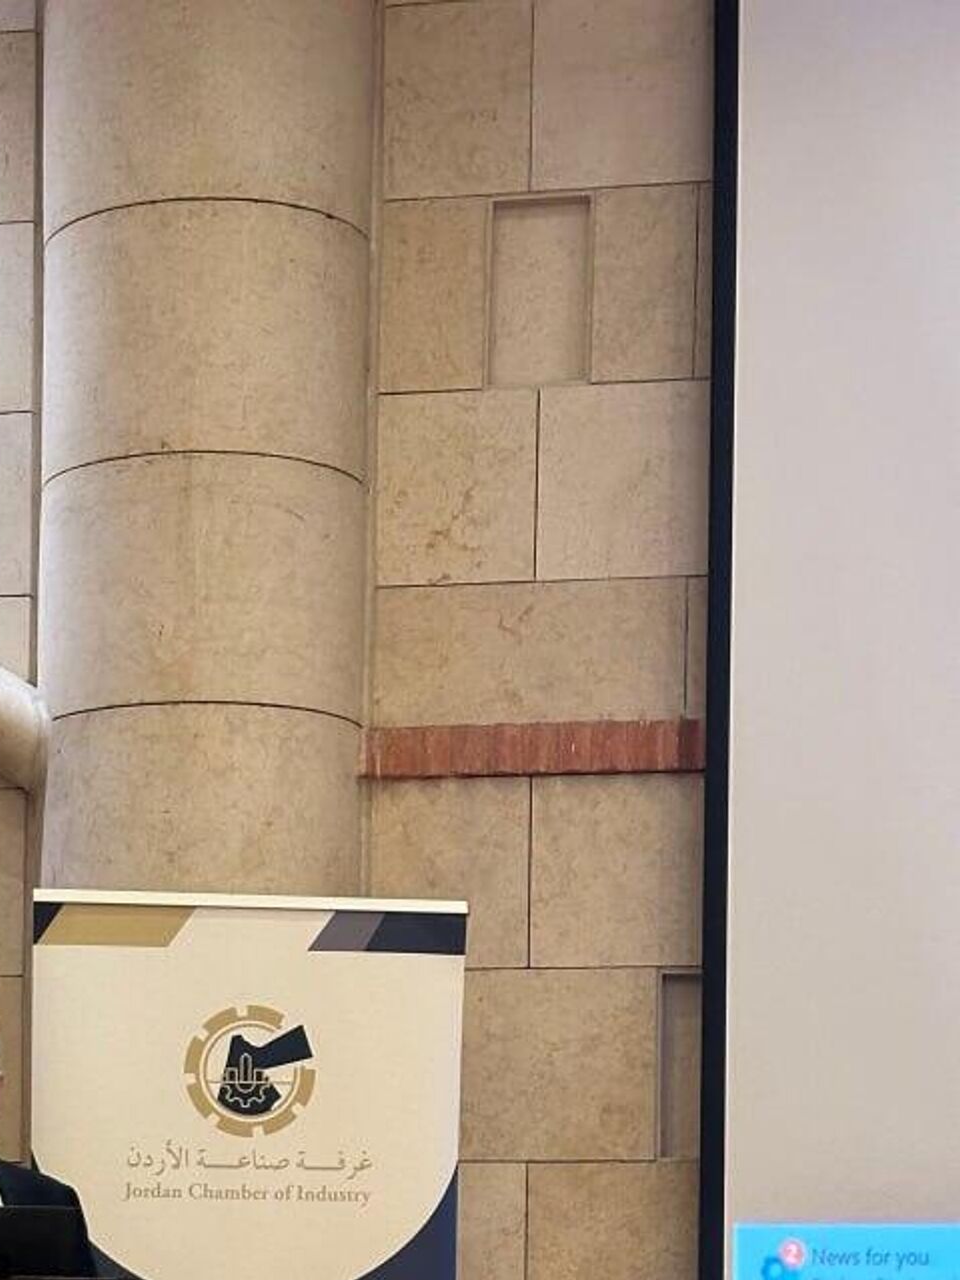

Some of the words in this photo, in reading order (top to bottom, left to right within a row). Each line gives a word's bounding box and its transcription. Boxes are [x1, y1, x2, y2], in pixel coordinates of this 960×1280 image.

[126, 1139, 190, 1176] الأردن
[124, 1182, 182, 1200] Jordan
[190, 1183, 267, 1201] Chamber
[274, 1184, 294, 1201] of
[297, 1184, 371, 1205] Industry
[811, 1248, 861, 1266] News
[865, 1246, 890, 1266] for
[892, 1250, 930, 1272] you
